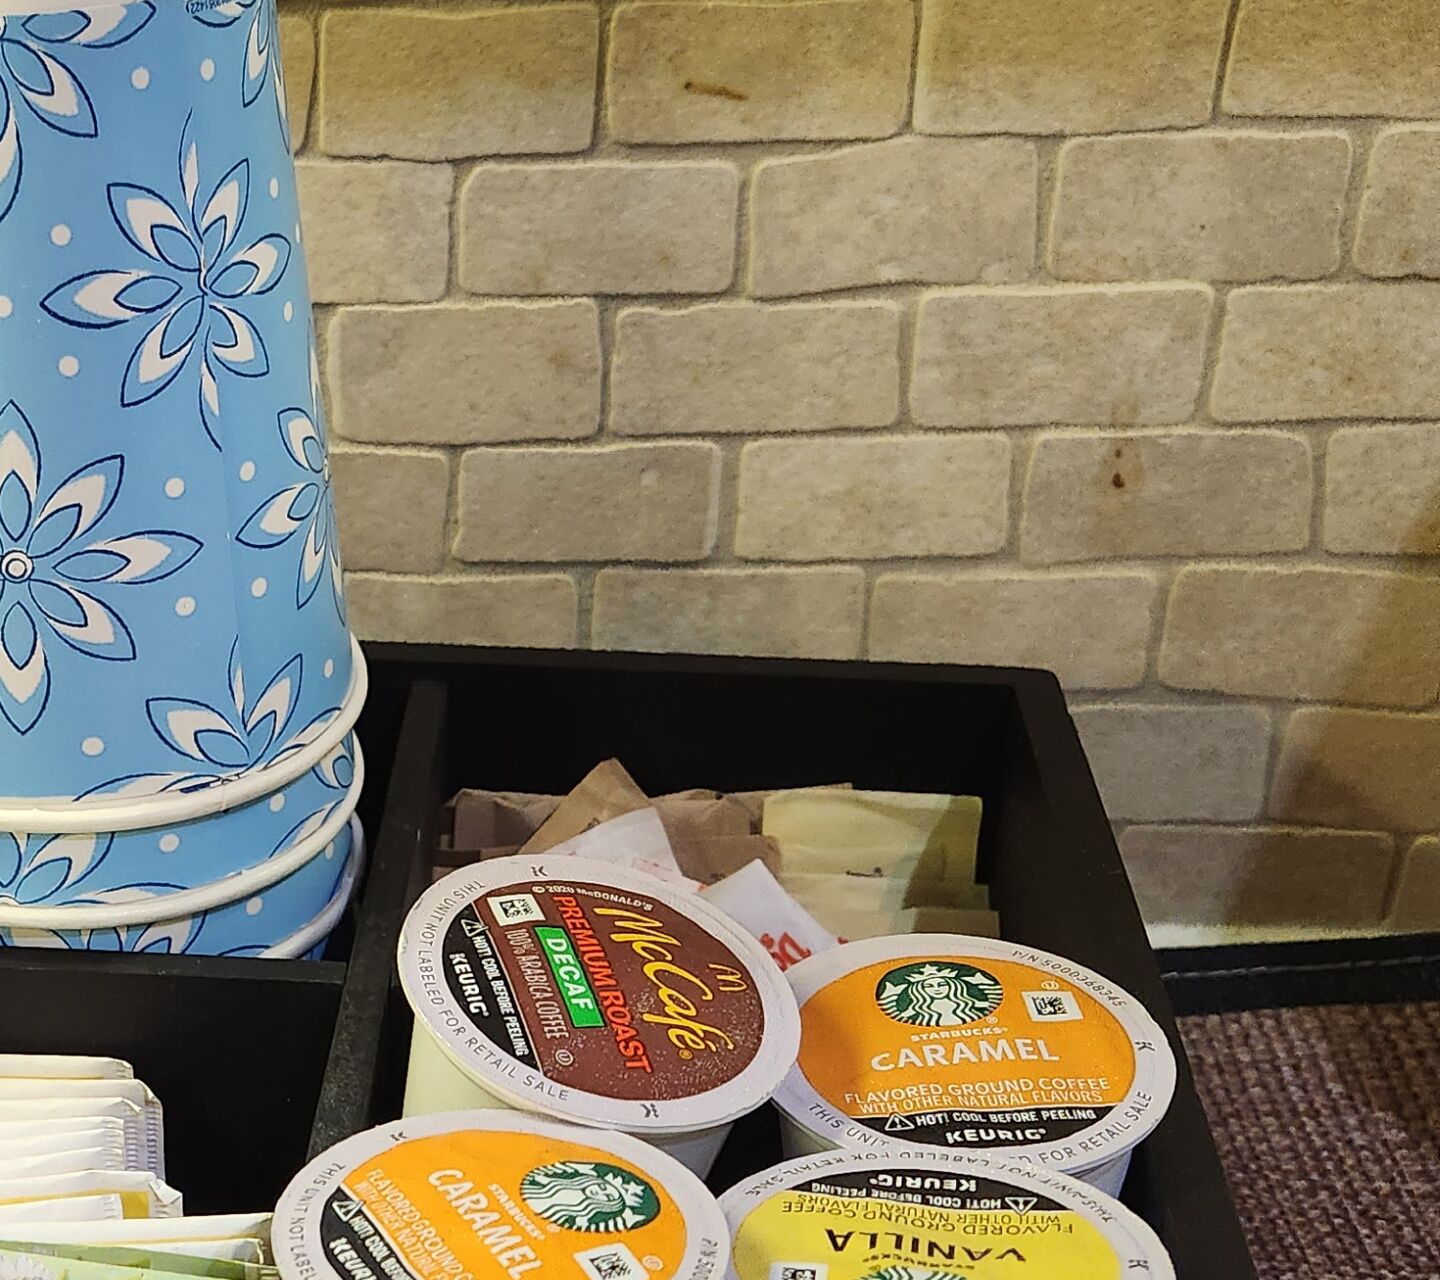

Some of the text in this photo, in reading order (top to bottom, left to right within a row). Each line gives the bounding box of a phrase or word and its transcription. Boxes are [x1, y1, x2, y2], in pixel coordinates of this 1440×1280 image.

[576, 887, 654, 912] McDONALD'S
[1011, 950, 1040, 963] P/N
[503, 928, 570, 1040] 100% ARABICA COFFEE
[546, 937, 594, 1011] DECAF
[553, 896, 653, 1074] PREMIUM ROAST
[418, 880, 570, 1102] THIS UNIT NOT LABELED FOR RETAIL SALE
[471, 935, 530, 1057] HOT! COOL BEFORE PEELING
[870, 1038, 1060, 1071] CARAMEL
[843, 1077, 1111, 1104] FLAVORED GROUND COFFEE
[859, 1088, 1104, 1115] WITH OTHER NATURAL FLAVORS
[807, 1101, 890, 1147] THIS UNIT
[915, 1108, 1098, 1127] HOT! COOL BEFORE PEELING
[1038, 1090, 1153, 1165] FOR RETAIL SALE
[850, 1152, 891, 1162] FOR
[899, 1151, 991, 1167] LABELED
[312, 1161, 347, 1187] THIS
[293, 1186, 320, 1214] UNIT
[797, 1193, 1061, 1226] WITH OTHER NATURAL FLAVORS
[811, 1182, 1003, 1210] HOT! COOL BEFORE PEELING
[288, 1216, 306, 1242] NOT
[365, 1167, 422, 1222] FLAVORED
[410, 1218, 465, 1274] GROUND
[781, 1200, 1074, 1236] FLAVORED GROUND COFFEE
[824, 1228, 1027, 1263] VANILLA
